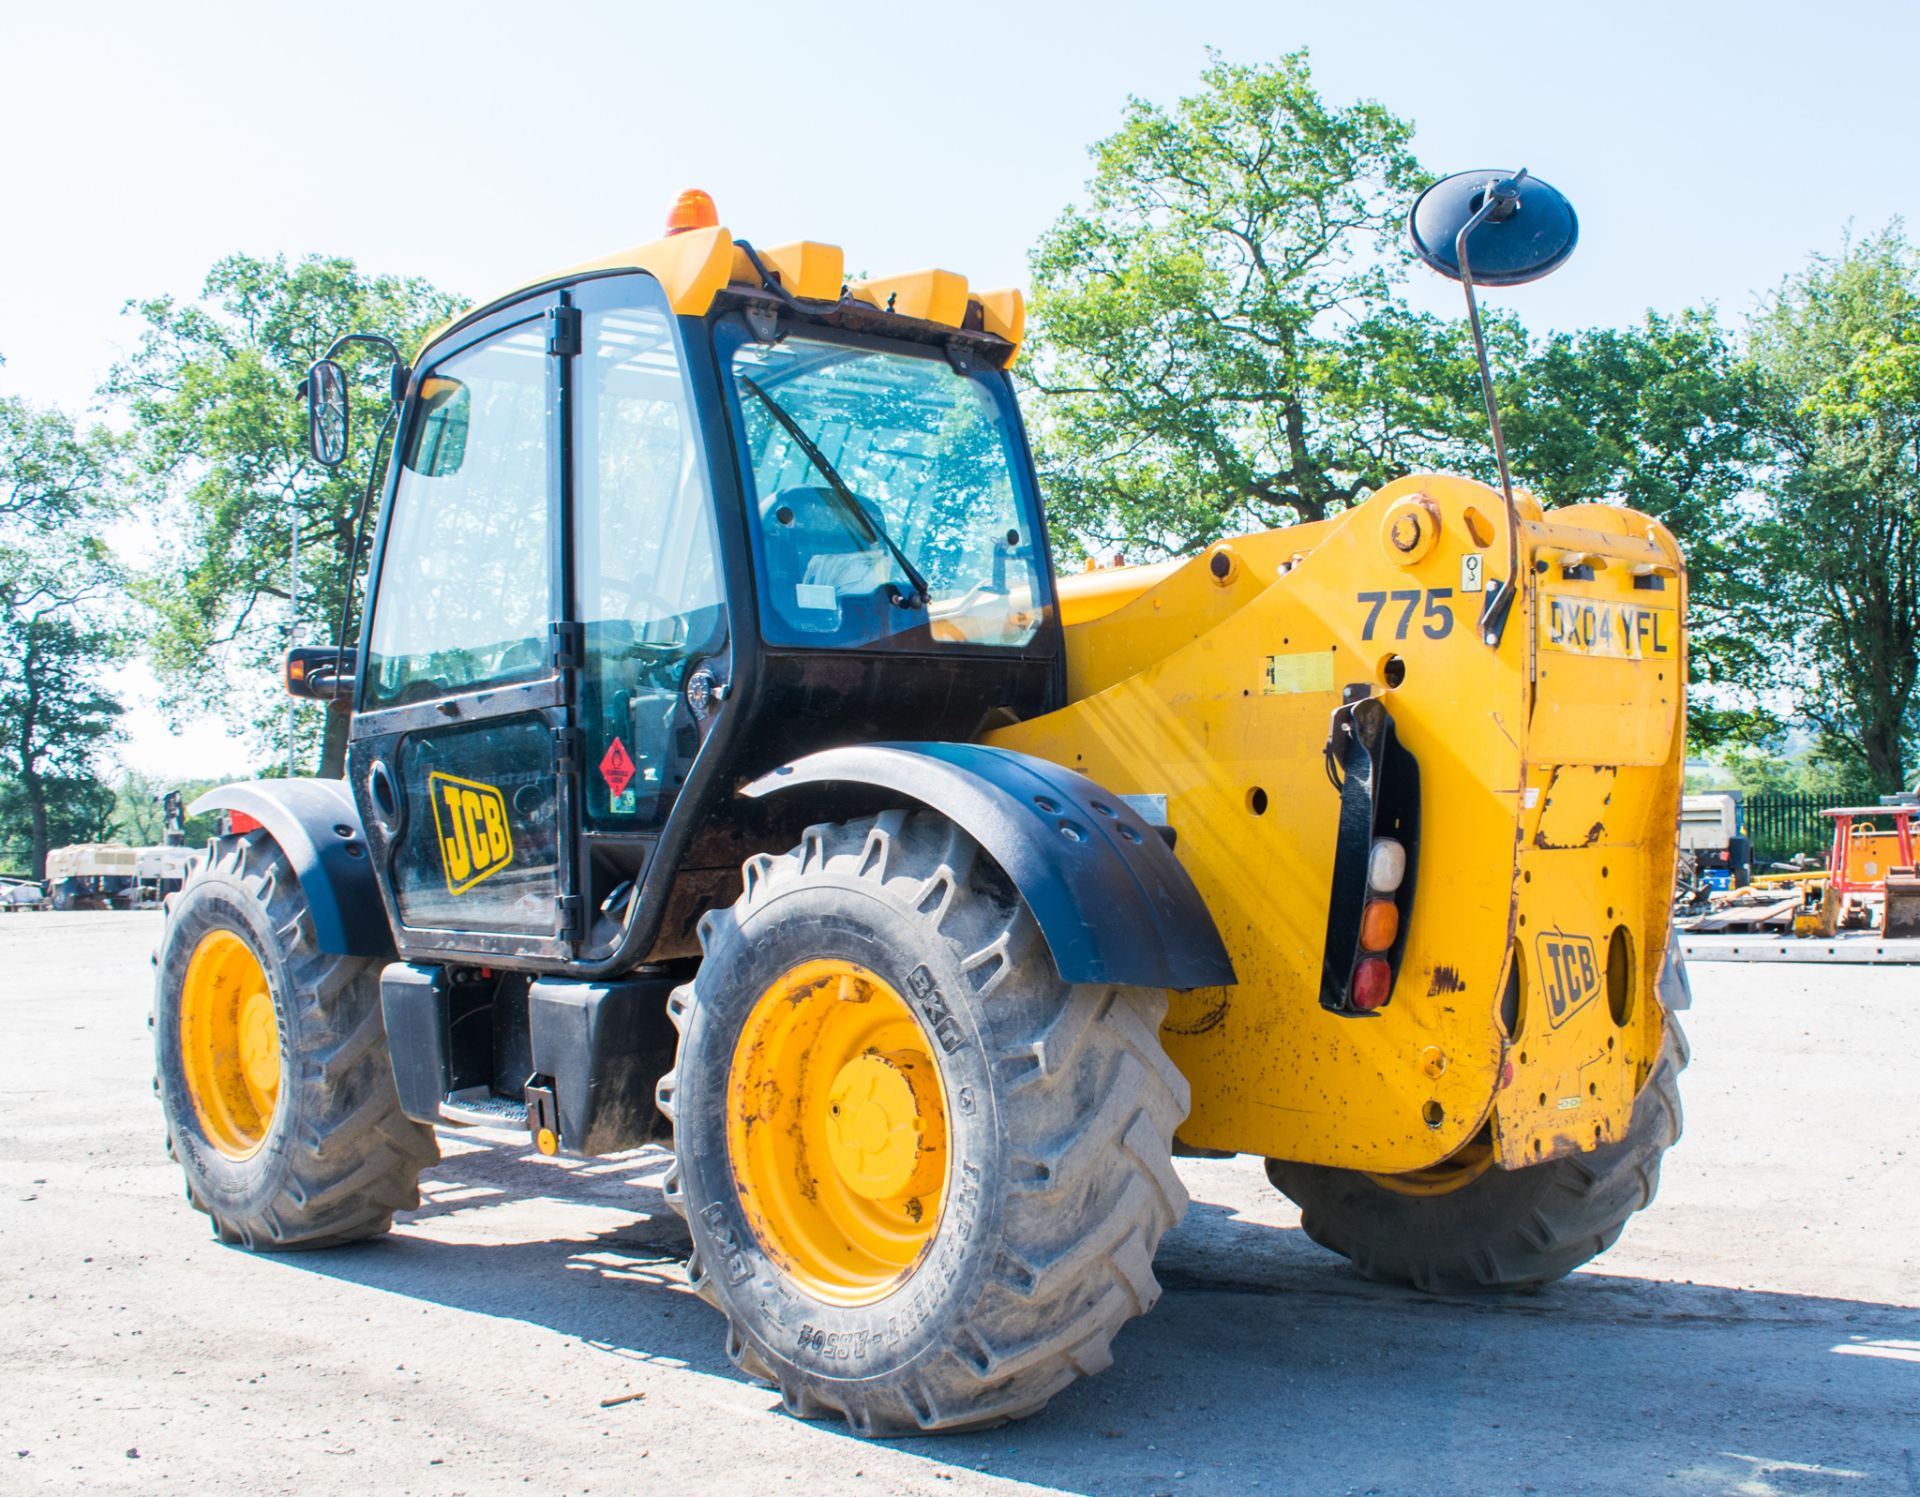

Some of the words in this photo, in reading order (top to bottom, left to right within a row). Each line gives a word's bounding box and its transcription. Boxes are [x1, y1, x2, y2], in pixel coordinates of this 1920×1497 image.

[1357, 588, 1454, 640] 775
[1550, 601, 1612, 648] DX04
[1621, 609, 1667, 652] YFL
[444, 786, 507, 882] JCB
[909, 965, 965, 1052] BKT
[1547, 942, 1595, 1017] JCB
[705, 1204, 751, 1284] BKT
